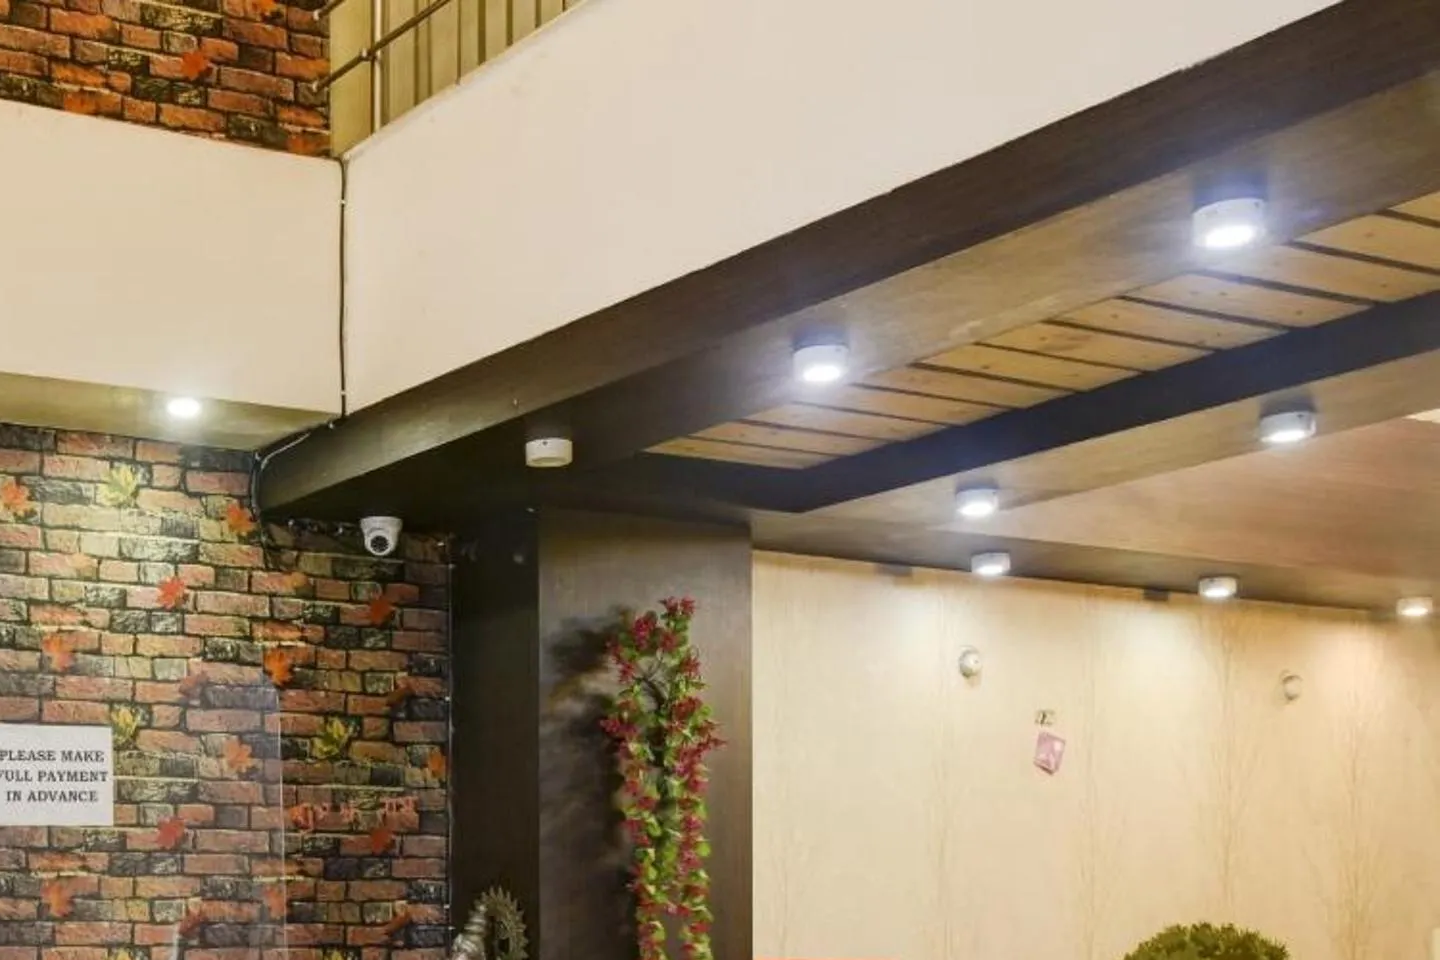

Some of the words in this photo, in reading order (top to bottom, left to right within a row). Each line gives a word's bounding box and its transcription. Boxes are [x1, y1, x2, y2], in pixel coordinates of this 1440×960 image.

[0, 749, 56, 762] PLEASE
[60, 749, 105, 763] MAKE
[37, 770, 109, 783] PAYMENT
[6, 790, 22, 802] IN
[27, 790, 98, 803] ADVANCE
